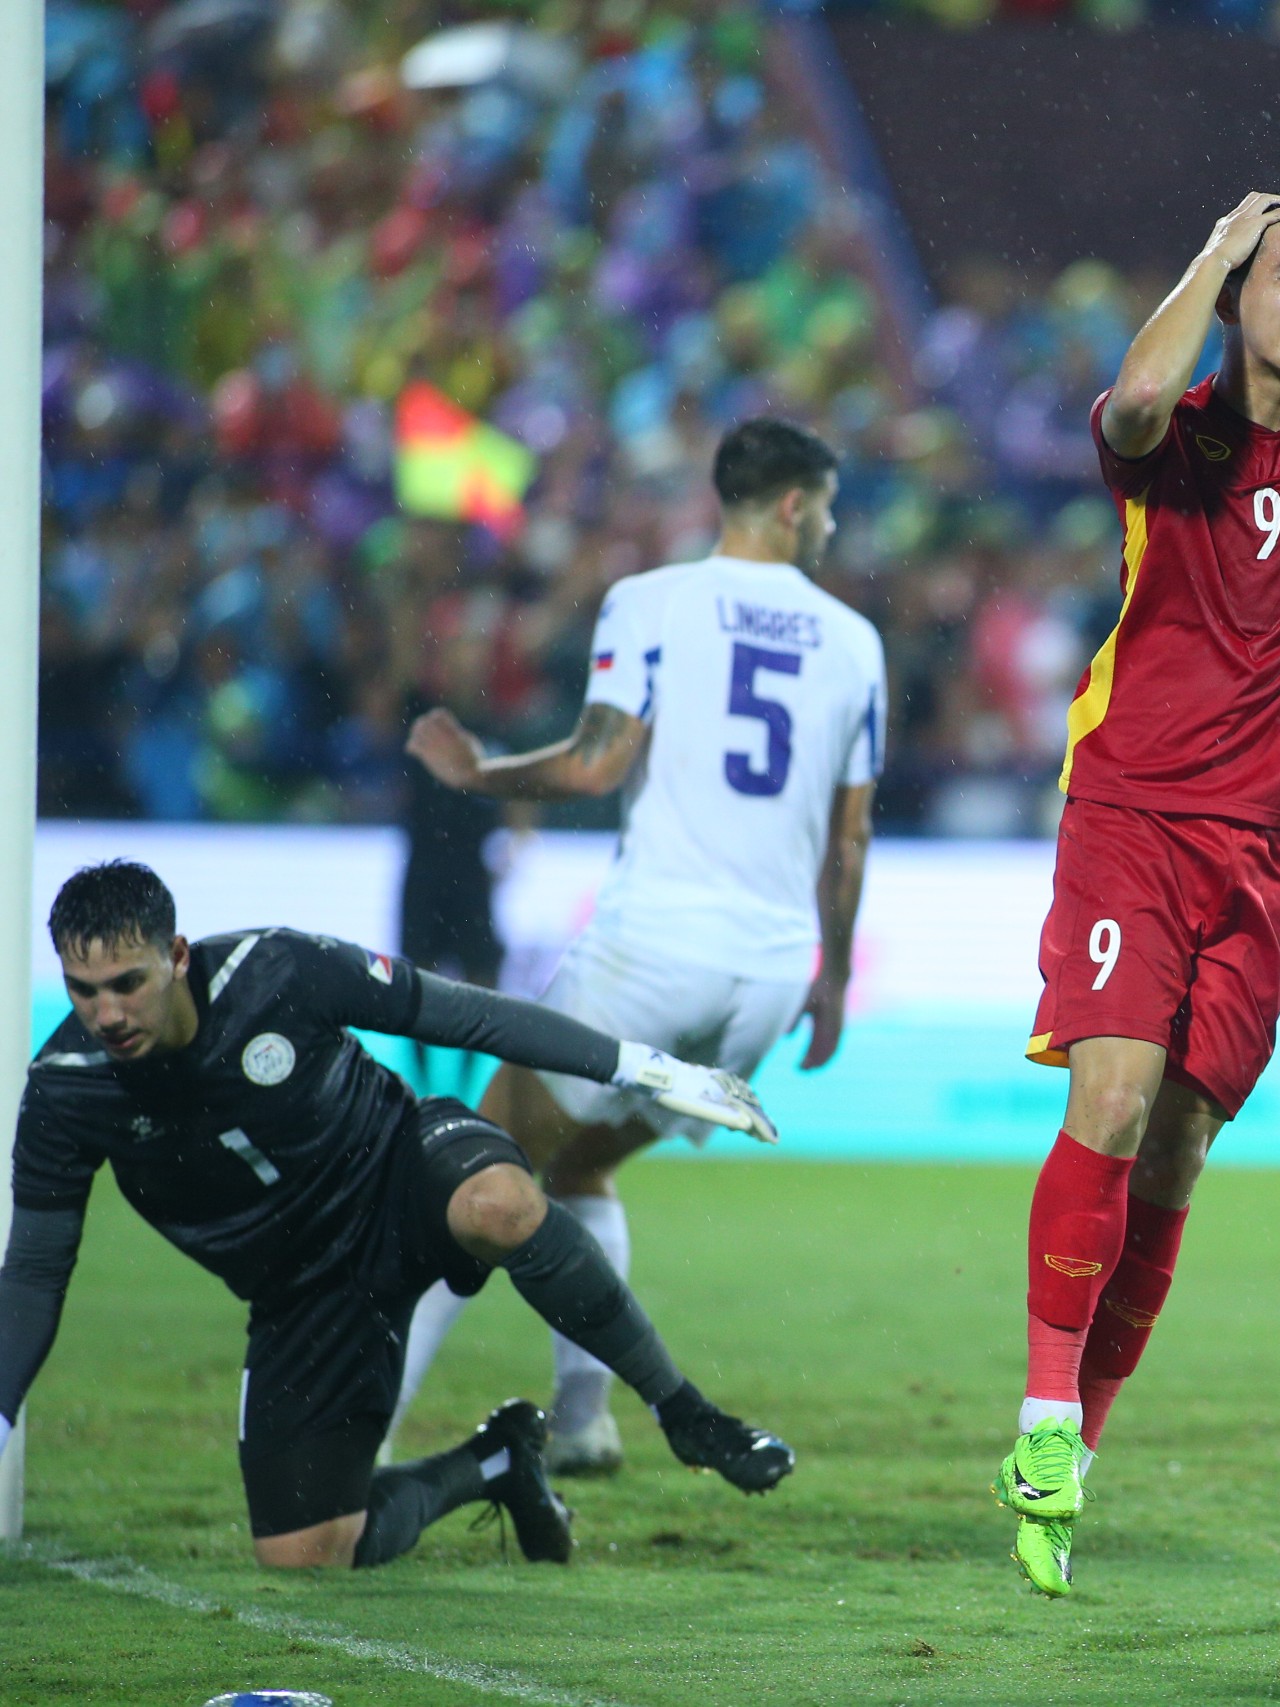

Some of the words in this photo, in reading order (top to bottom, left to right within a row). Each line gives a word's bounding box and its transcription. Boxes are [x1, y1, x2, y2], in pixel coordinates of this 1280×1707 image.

[716, 597, 823, 648] LINARES
[724, 641, 802, 797] 5
[1088, 918, 1122, 991] 9
[218, 1126, 281, 1186] 1
